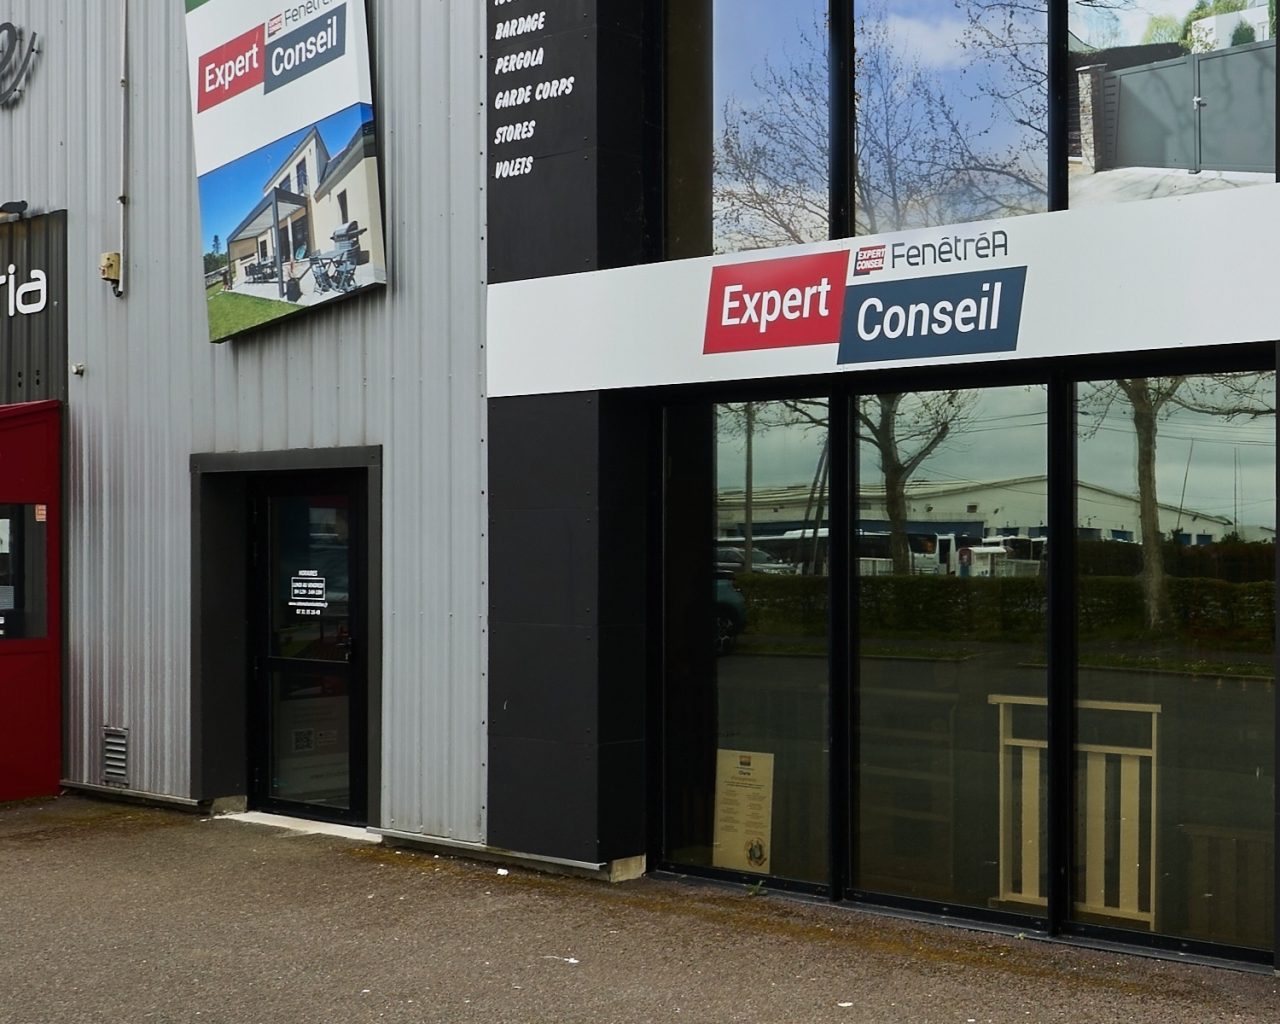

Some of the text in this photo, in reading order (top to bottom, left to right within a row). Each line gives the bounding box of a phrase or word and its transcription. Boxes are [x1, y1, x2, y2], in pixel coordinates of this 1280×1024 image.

[494, 11, 546, 40] BARDAGE
[270, 15, 338, 78] Conseil
[494, 47, 544, 75] PERGOLA
[204, 42, 259, 94] Expert
[494, 75, 575, 110] GARDE CORPS
[494, 119, 536, 145] STORES
[494, 155, 533, 179] VOLETS
[856, 258, 884, 271] CONSEIL
[857, 248, 885, 261] EXPERT
[891, 230, 1008, 269] FenêtréA
[0, 264, 47, 317] ia
[721, 277, 1003, 341] Expert Conseil
